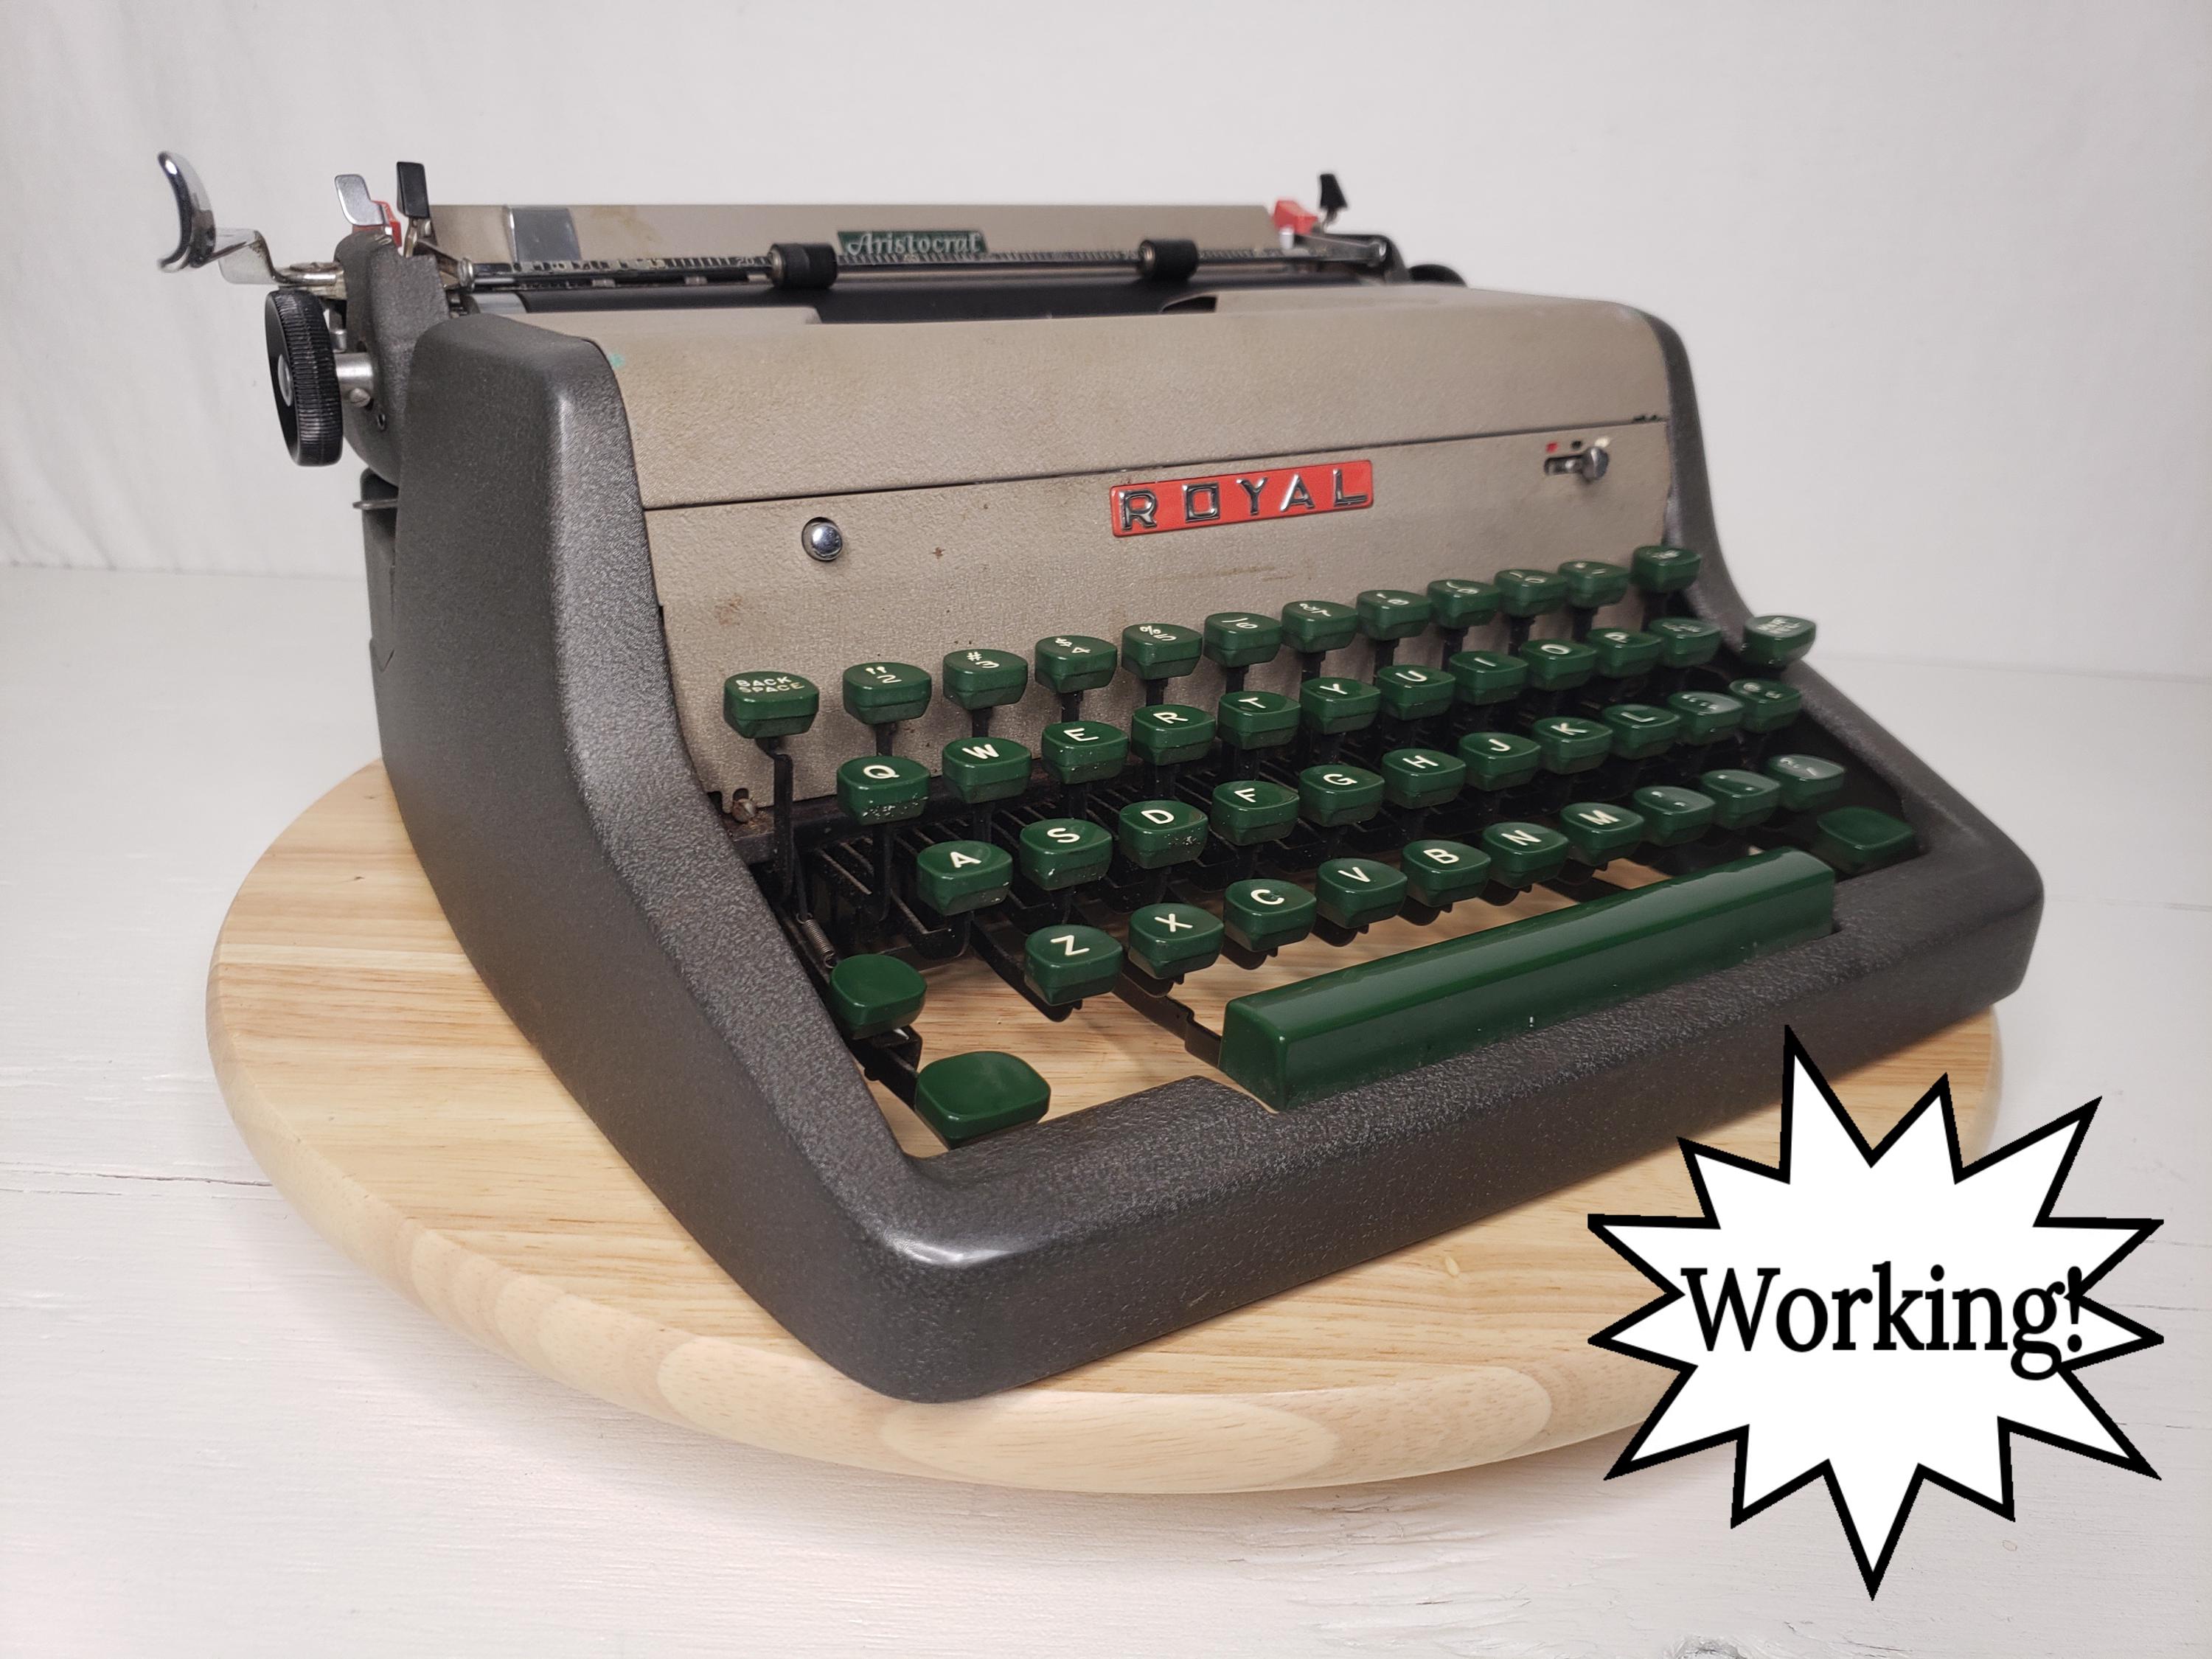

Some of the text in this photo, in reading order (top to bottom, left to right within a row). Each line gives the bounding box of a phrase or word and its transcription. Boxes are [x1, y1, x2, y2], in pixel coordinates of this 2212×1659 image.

[847, 232, 981, 255] Aristocrat
[1119, 468, 1368, 531] ROYAL
[967, 651, 983, 662] #
[975, 660, 1001, 669] 3
[735, 676, 793, 687] BACK
[876, 674, 903, 684] 2
[1395, 669, 1428, 682] U
[738, 681, 806, 693] SPACE
[1318, 683, 1349, 695] Y
[1238, 697, 1267, 709] T
[1152, 712, 1189, 724] R
[1620, 711, 1658, 723] L
[1062, 727, 1100, 742] E
[1550, 722, 1590, 736] K
[961, 743, 1001, 759] W
[1488, 738, 1512, 751] J
[1402, 755, 1439, 768] H
[863, 765, 900, 779] Q
[1322, 773, 1358, 786] G
[1234, 787, 1257, 803] F
[1140, 809, 1175, 825] D
[1577, 809, 1621, 826] M
[1046, 827, 1081, 844] S
[1500, 829, 1543, 846] N
[950, 851, 982, 869] A
[1422, 848, 1460, 865] B
[1337, 866, 1371, 883] V
[1250, 888, 1285, 905] C
[1154, 913, 1194, 933] X
[1050, 934, 1091, 956] Z
